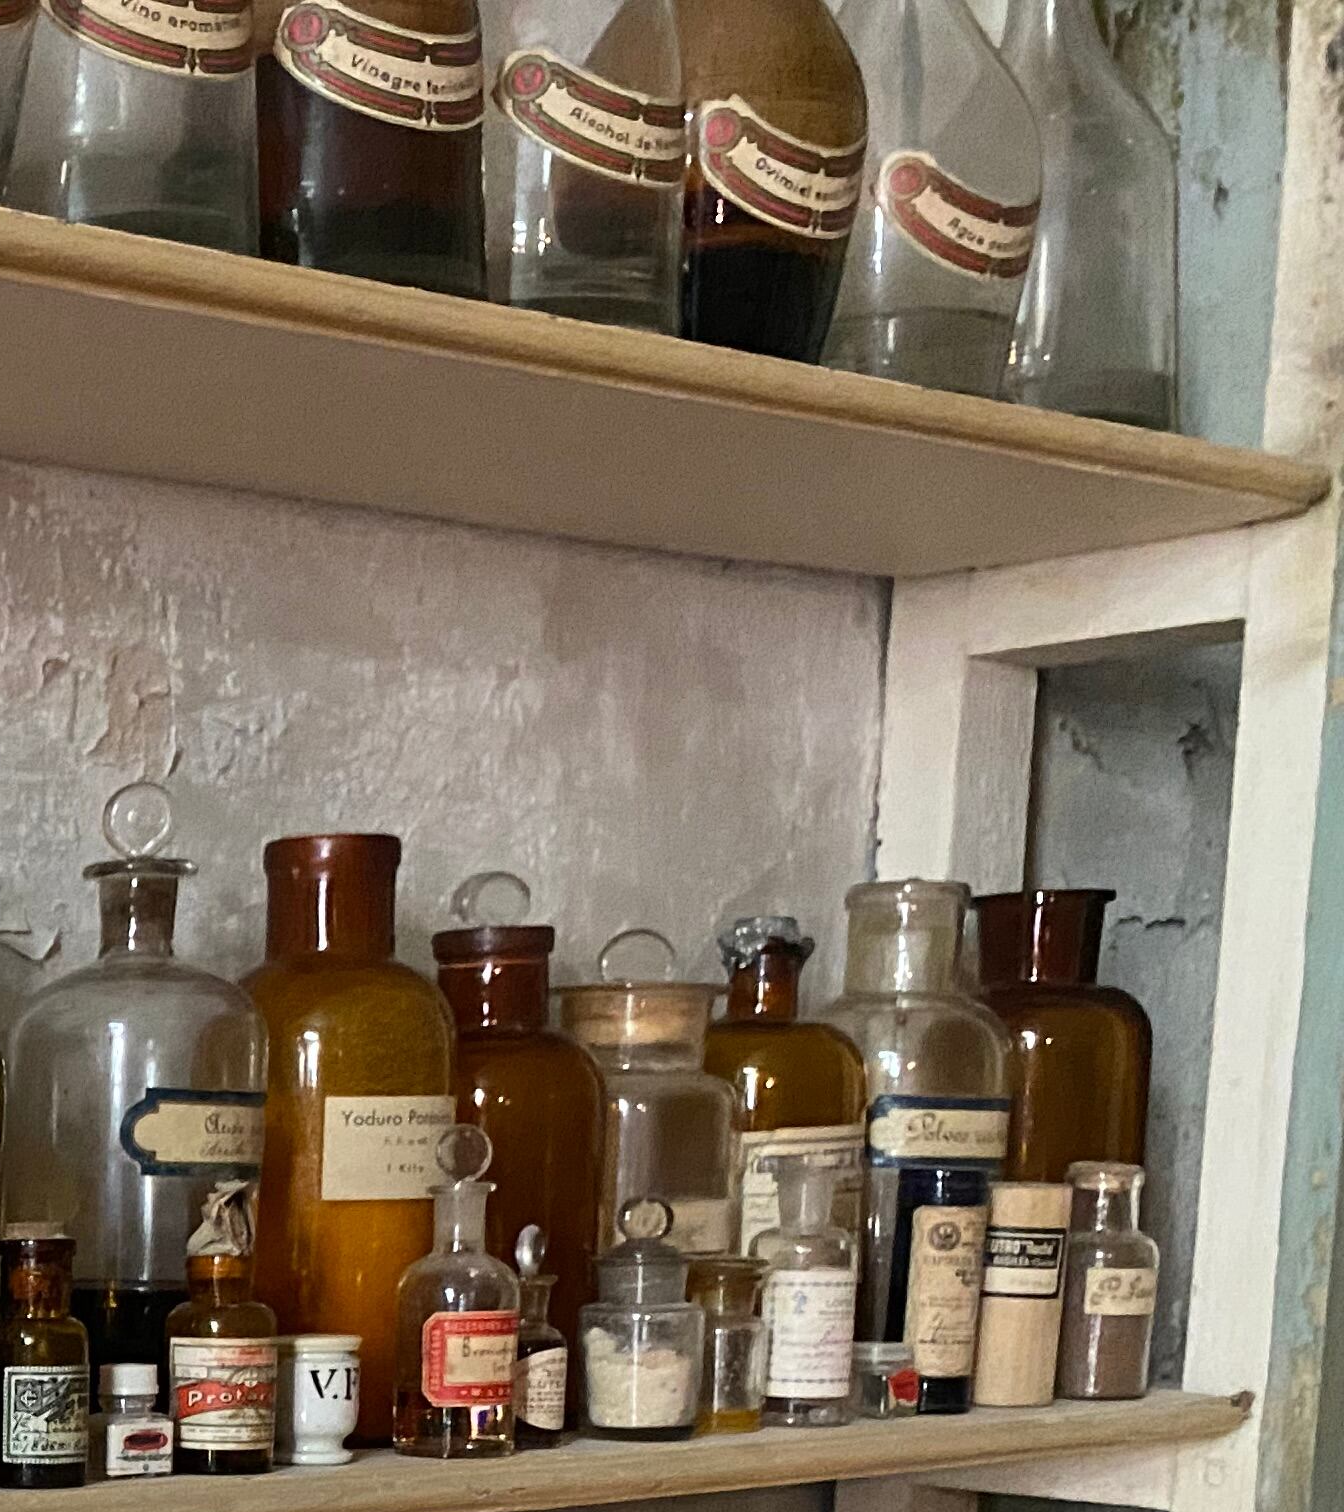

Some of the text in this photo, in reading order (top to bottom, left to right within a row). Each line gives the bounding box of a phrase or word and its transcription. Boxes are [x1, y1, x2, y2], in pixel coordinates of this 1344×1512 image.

[351, 53, 422, 93] Vinagre
[569, 106, 631, 145] Alcohol
[947, 216, 985, 246] Agua
[341, 1109, 402, 1126] Yoduro
